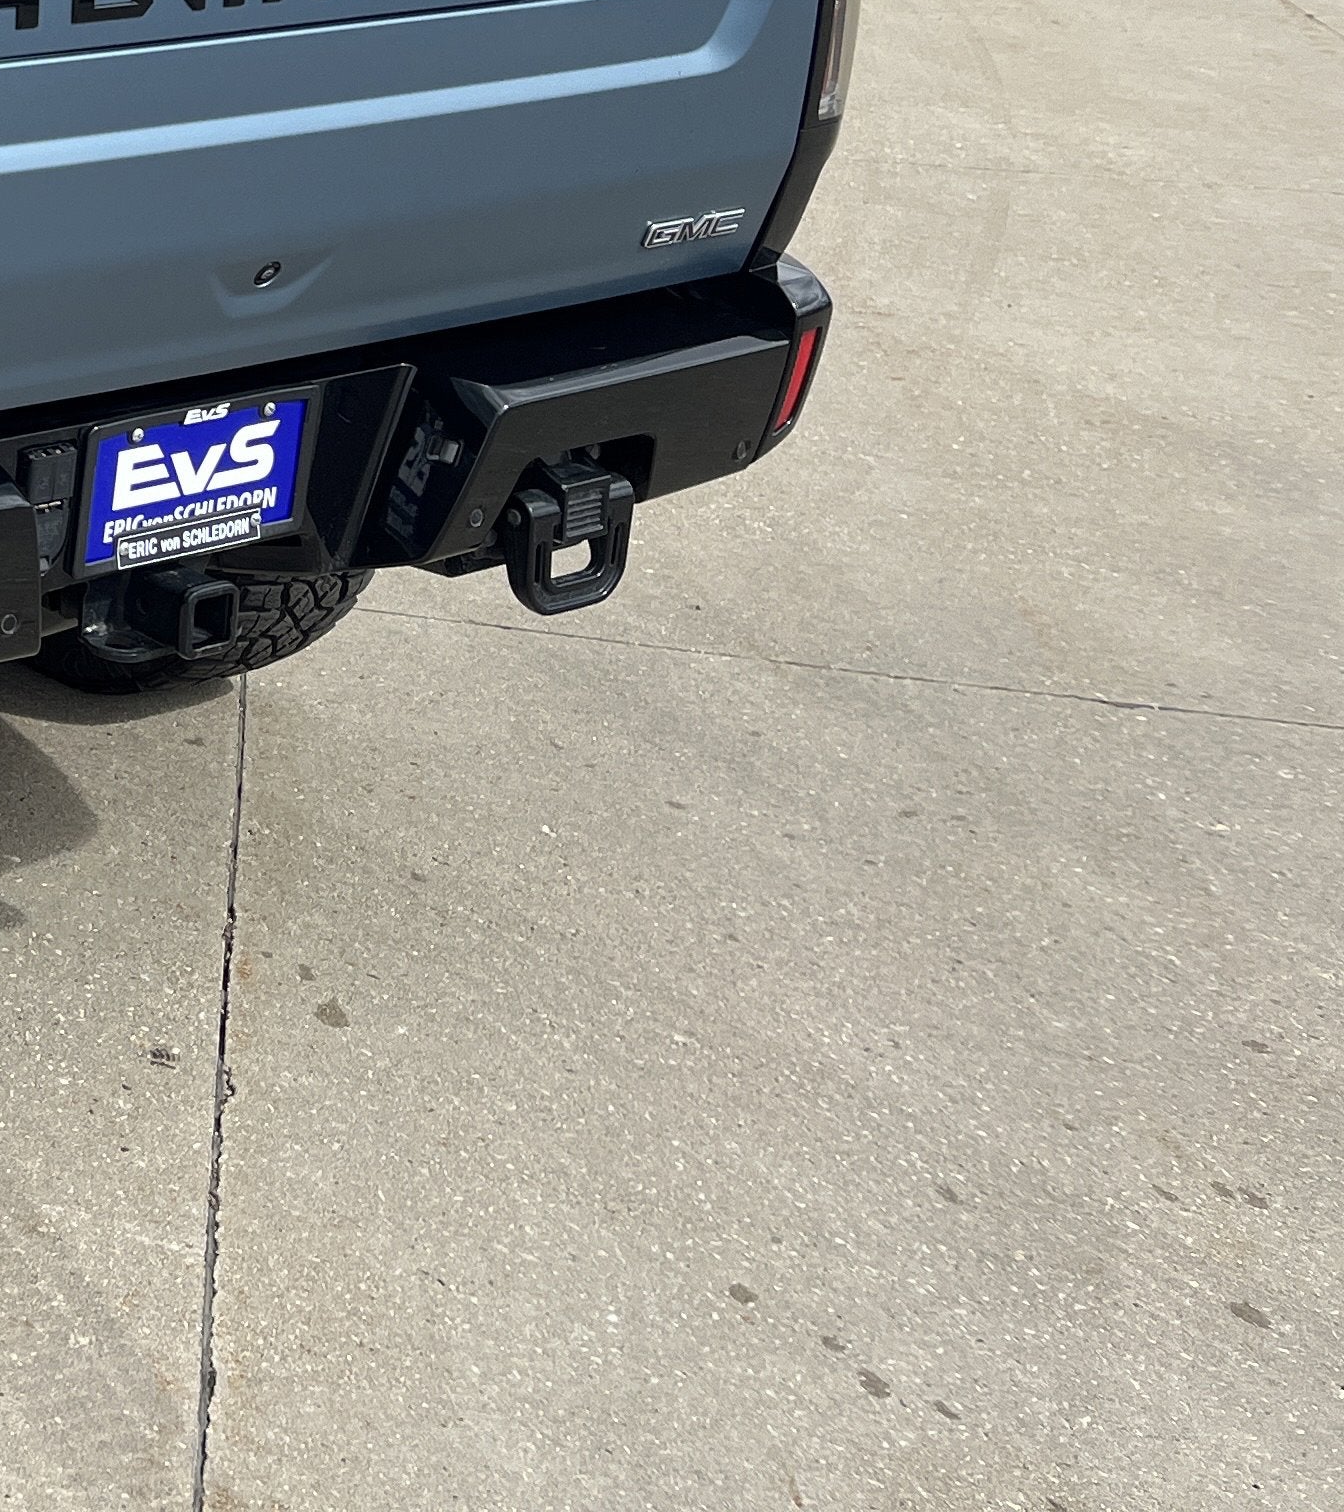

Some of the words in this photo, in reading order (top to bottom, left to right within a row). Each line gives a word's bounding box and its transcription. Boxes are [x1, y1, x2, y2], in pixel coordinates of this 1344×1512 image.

[641, 208, 745, 248] GMC
[128, 539, 158, 559] ERIC
[160, 536, 181, 552] von
[182, 517, 250, 548] SCHLEDORN
